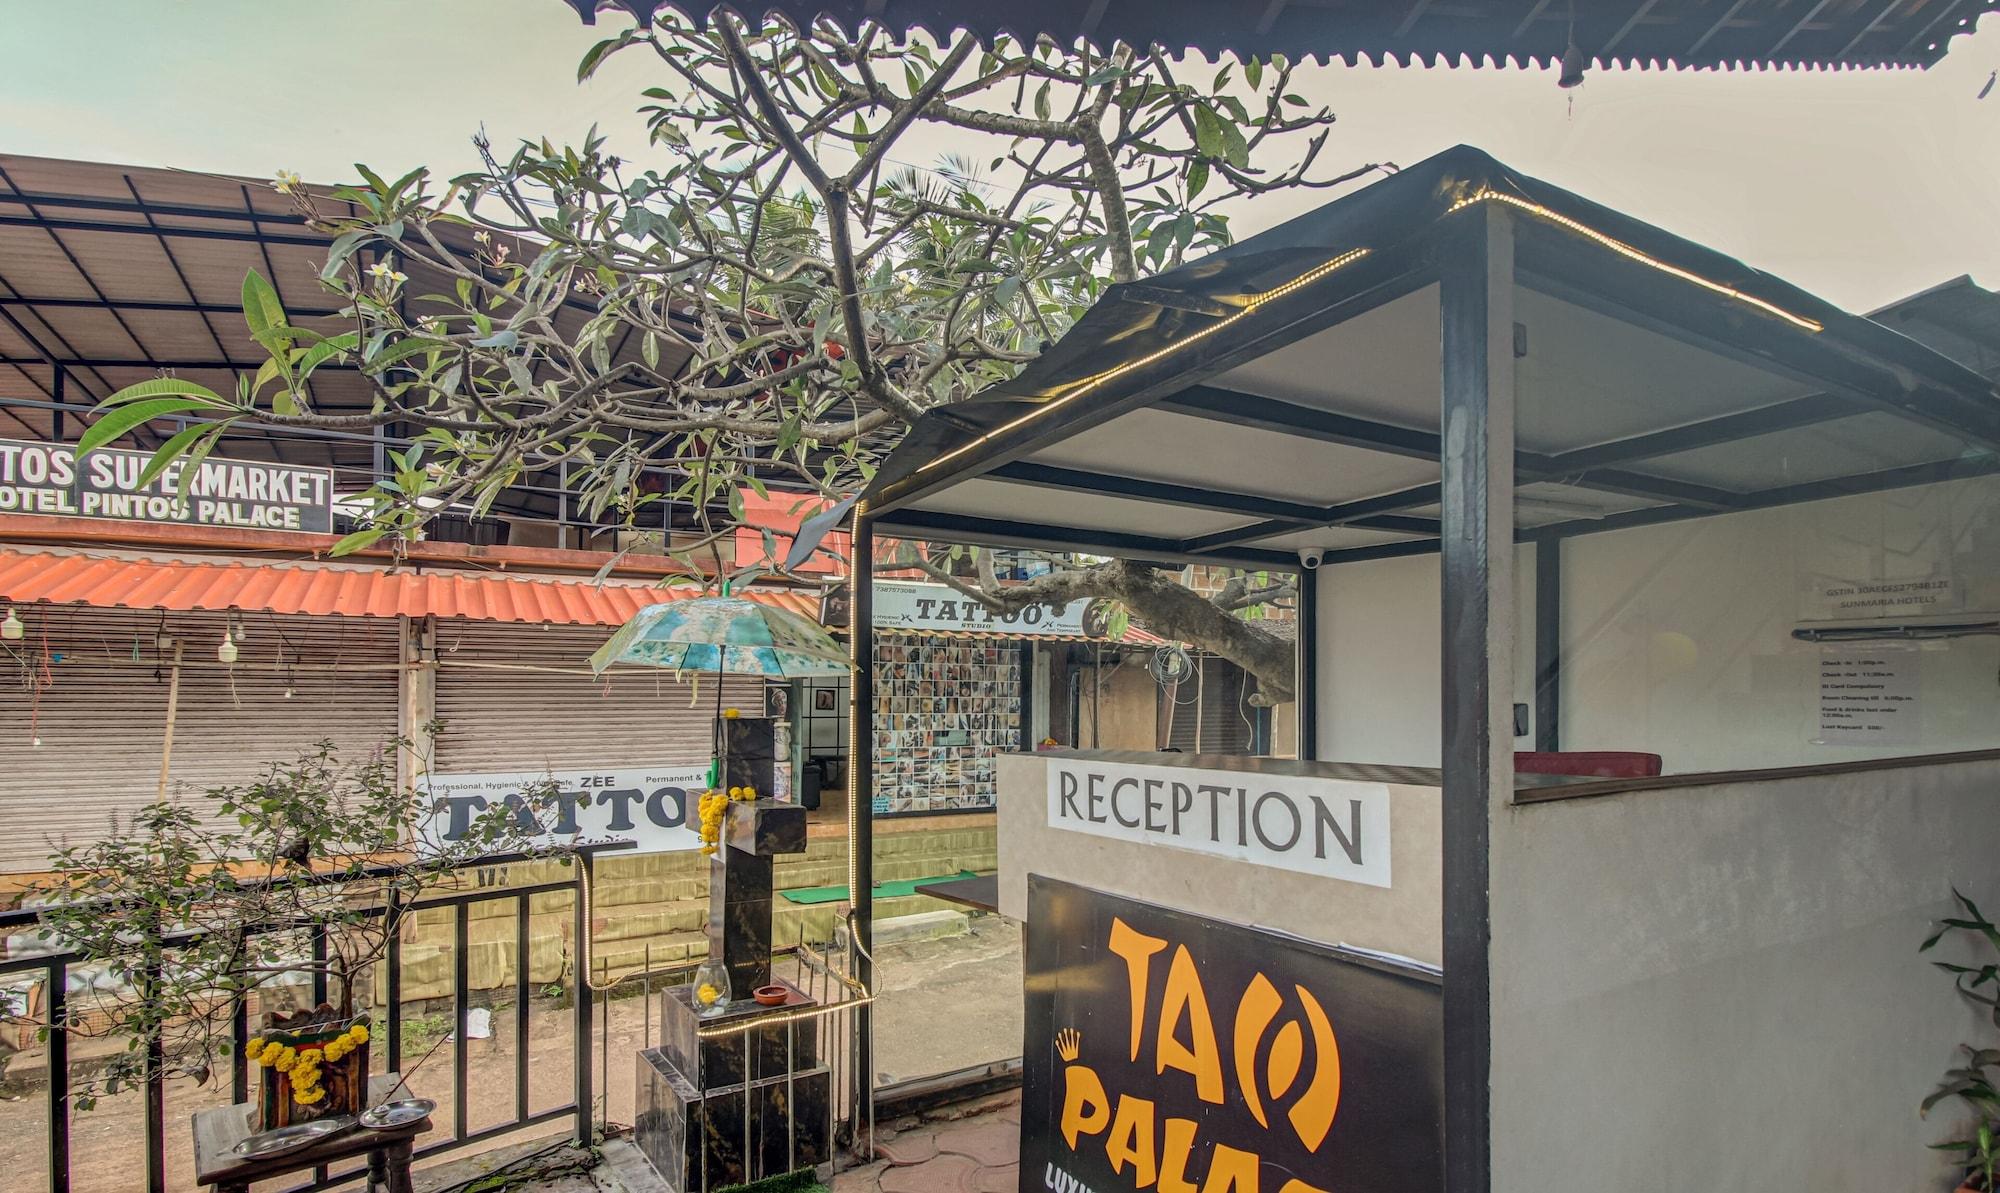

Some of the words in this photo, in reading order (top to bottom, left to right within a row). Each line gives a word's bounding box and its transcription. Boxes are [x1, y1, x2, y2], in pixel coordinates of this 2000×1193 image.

[199, 500, 301, 529] PALACE
[1897, 595, 1936, 606] HOTELS
[960, 622, 992, 630] STUDIO
[580, 776, 616, 788] ZEE
[646, 774, 693, 783] Permanent
[485, 781, 522, 790] Hygienic
[1059, 770, 1363, 866] RECEPTION
